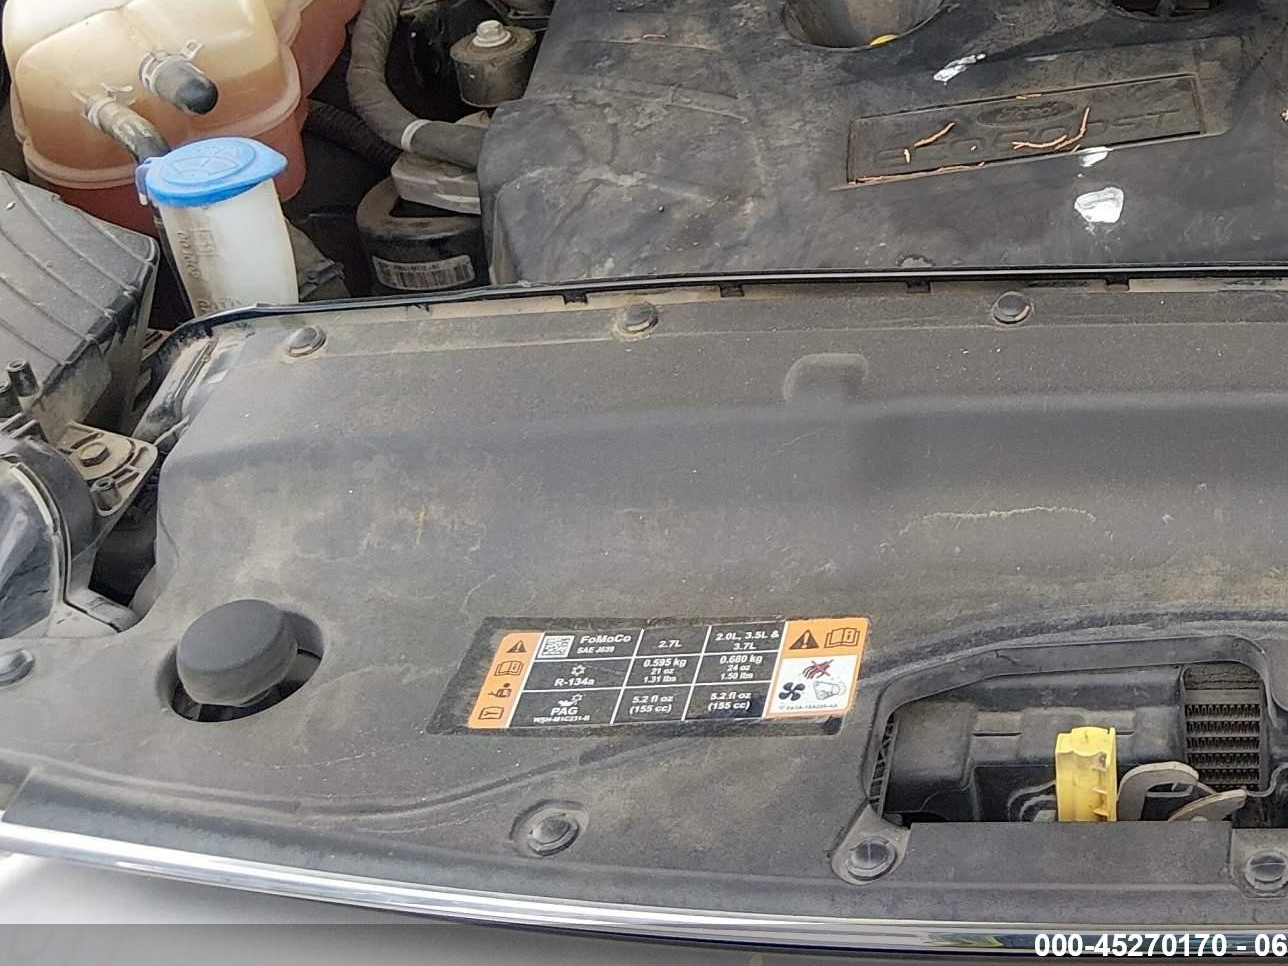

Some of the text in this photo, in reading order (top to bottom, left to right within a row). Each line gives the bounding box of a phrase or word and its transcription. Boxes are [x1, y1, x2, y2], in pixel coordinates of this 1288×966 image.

[580, 634, 632, 644] FoMoCo
[715, 630, 780, 641] 2.0L, 3.5L &
[658, 640, 682, 648] 2.7L
[732, 642, 757, 650] 3.7L
[643, 658, 687, 668] 0.595 kg
[720, 654, 763, 665] 0.680 kg
[554, 677, 595, 687] R-134a
[632, 695, 648, 703] 5.2
[650, 695, 658, 703] fl
[710, 692, 726, 700] 5.2
[728, 691, 736, 700] fl
[629, 705, 672, 714] (155 cc)
[708, 700, 750, 711] (155 cc)
[551, 706, 579, 715] PAG
